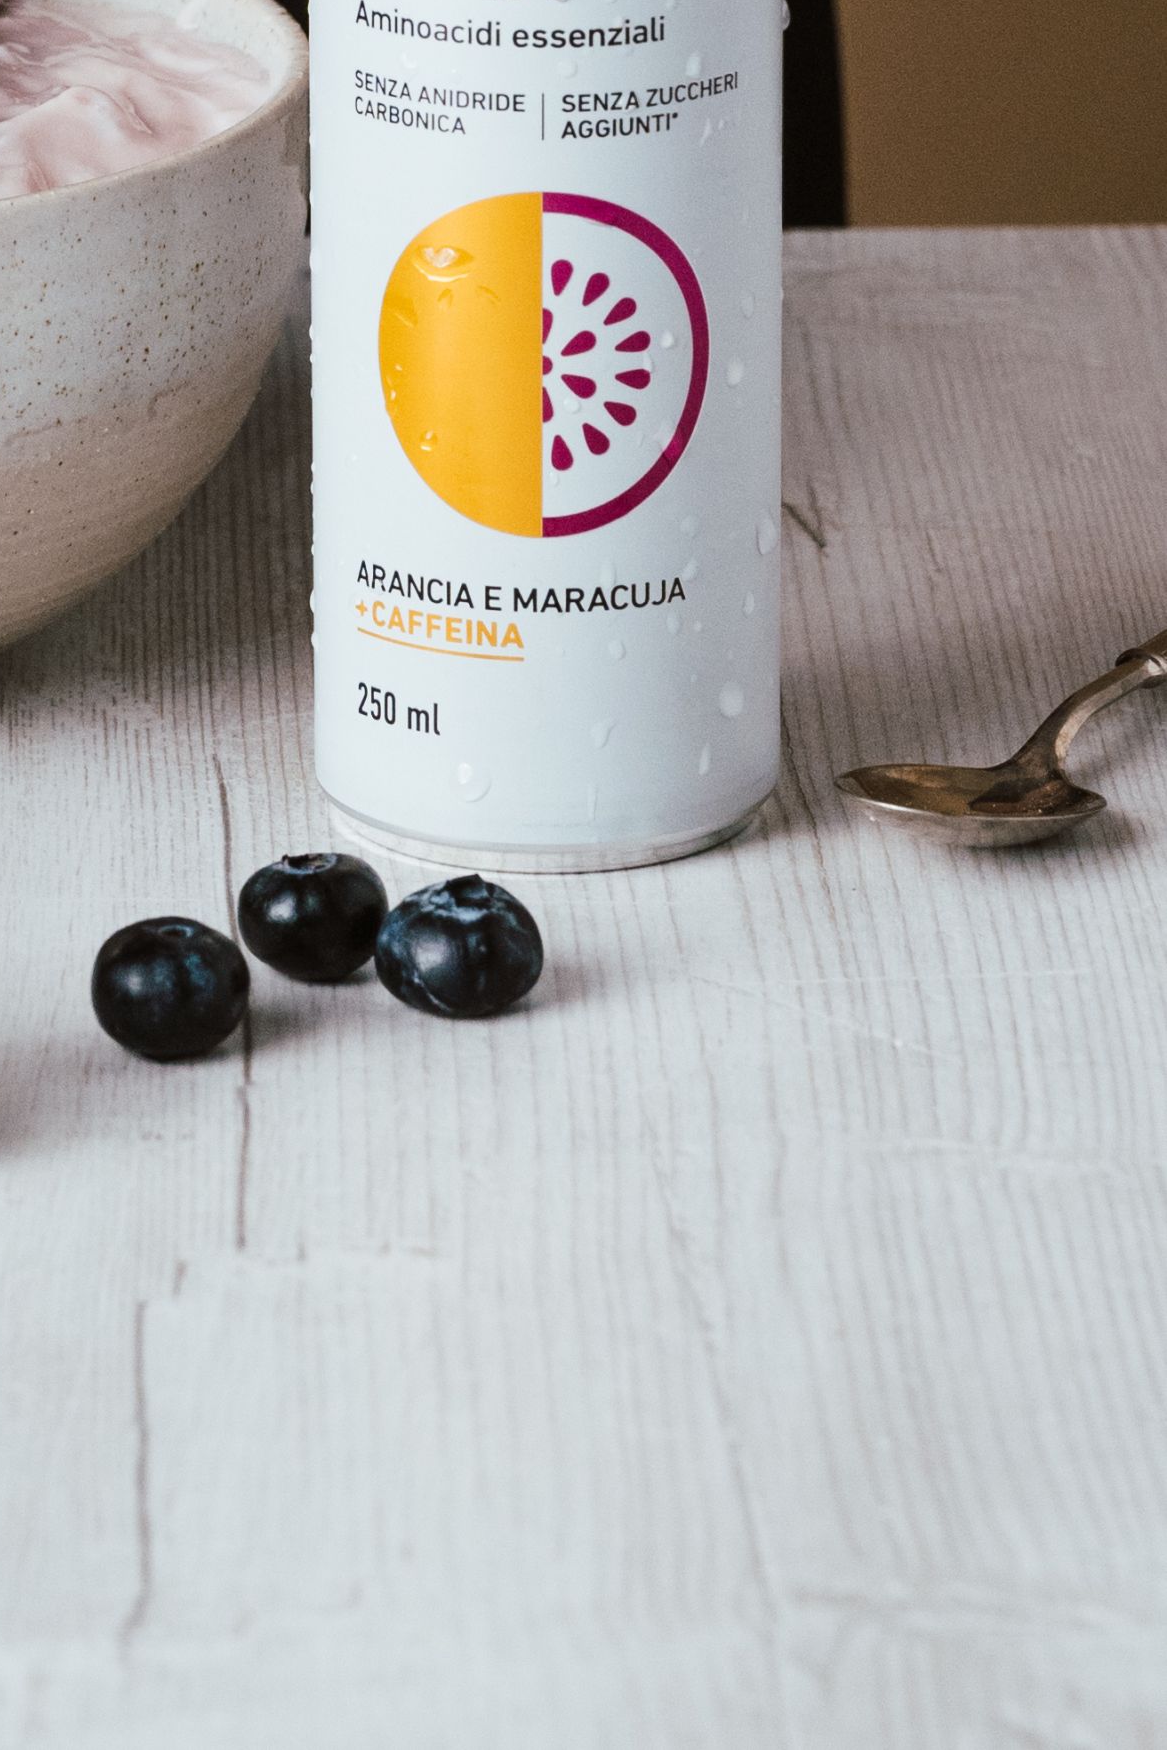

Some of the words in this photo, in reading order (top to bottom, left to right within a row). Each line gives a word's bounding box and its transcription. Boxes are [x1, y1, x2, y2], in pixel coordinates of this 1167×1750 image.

[355, 0, 502, 47] Aminoacidi
[511, 15, 666, 49] essenziali
[354, 69, 412, 101] SENZA
[417, 86, 526, 113] ANIDRIDE
[561, 91, 639, 113] SENZA
[645, 71, 739, 109] ZUCCHERI
[354, 96, 466, 136] CARBONICA
[356, 560, 474, 609] ARANCIA
[484, 586, 502, 612] E
[512, 576, 686, 614] MARACUJA
[357, 681, 397, 726] 250
[407, 702, 441, 736] ml
